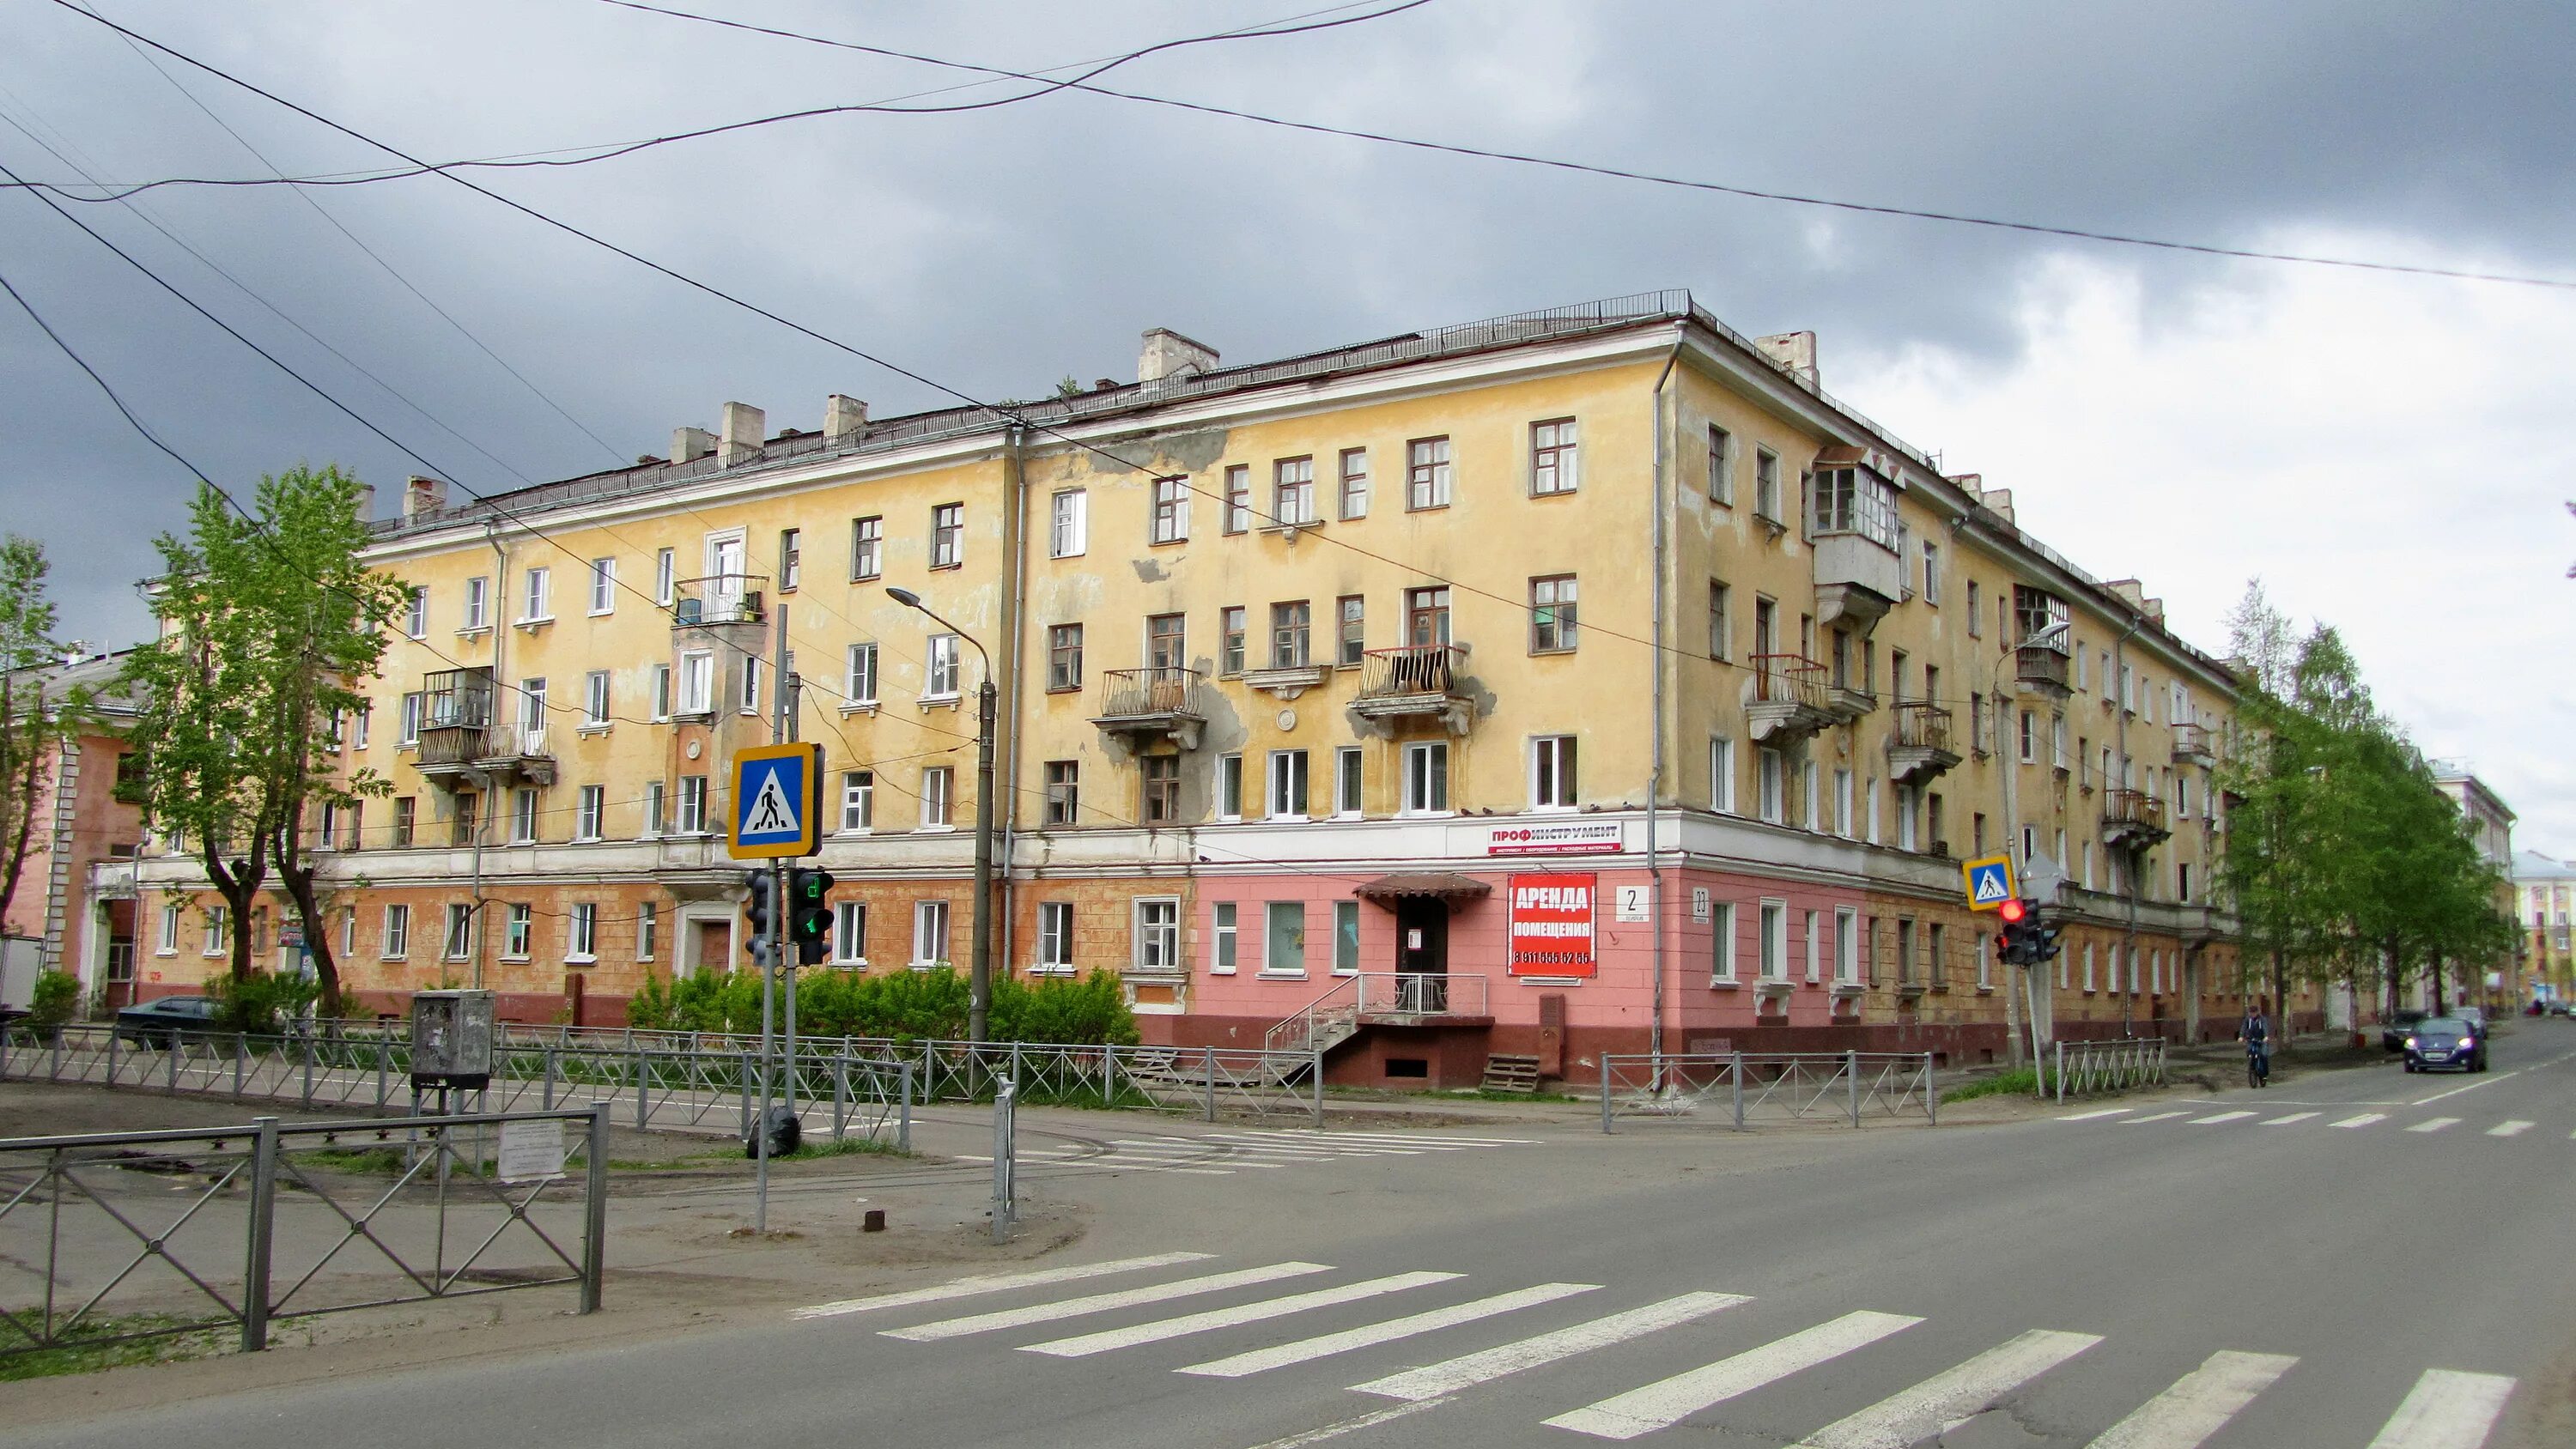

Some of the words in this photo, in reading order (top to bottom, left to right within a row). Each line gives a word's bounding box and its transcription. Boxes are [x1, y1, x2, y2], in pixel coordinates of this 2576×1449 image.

[1492, 826, 1618, 842] ПРОФИНСТРУМЕНТ
[1516, 887, 1588, 912] АРЕНДА
[1628, 890, 1636, 911] 2
[1697, 891, 1705, 912] 23
[1514, 922, 1590, 939] ПОМЕЩЕНИЯ
[1513, 951, 1520, 962] 8
[1522, 951, 1537, 963] 911
[1540, 951, 1558, 963] 555
[1561, 951, 1573, 964] 52
[1576, 951, 1589, 964] 55
